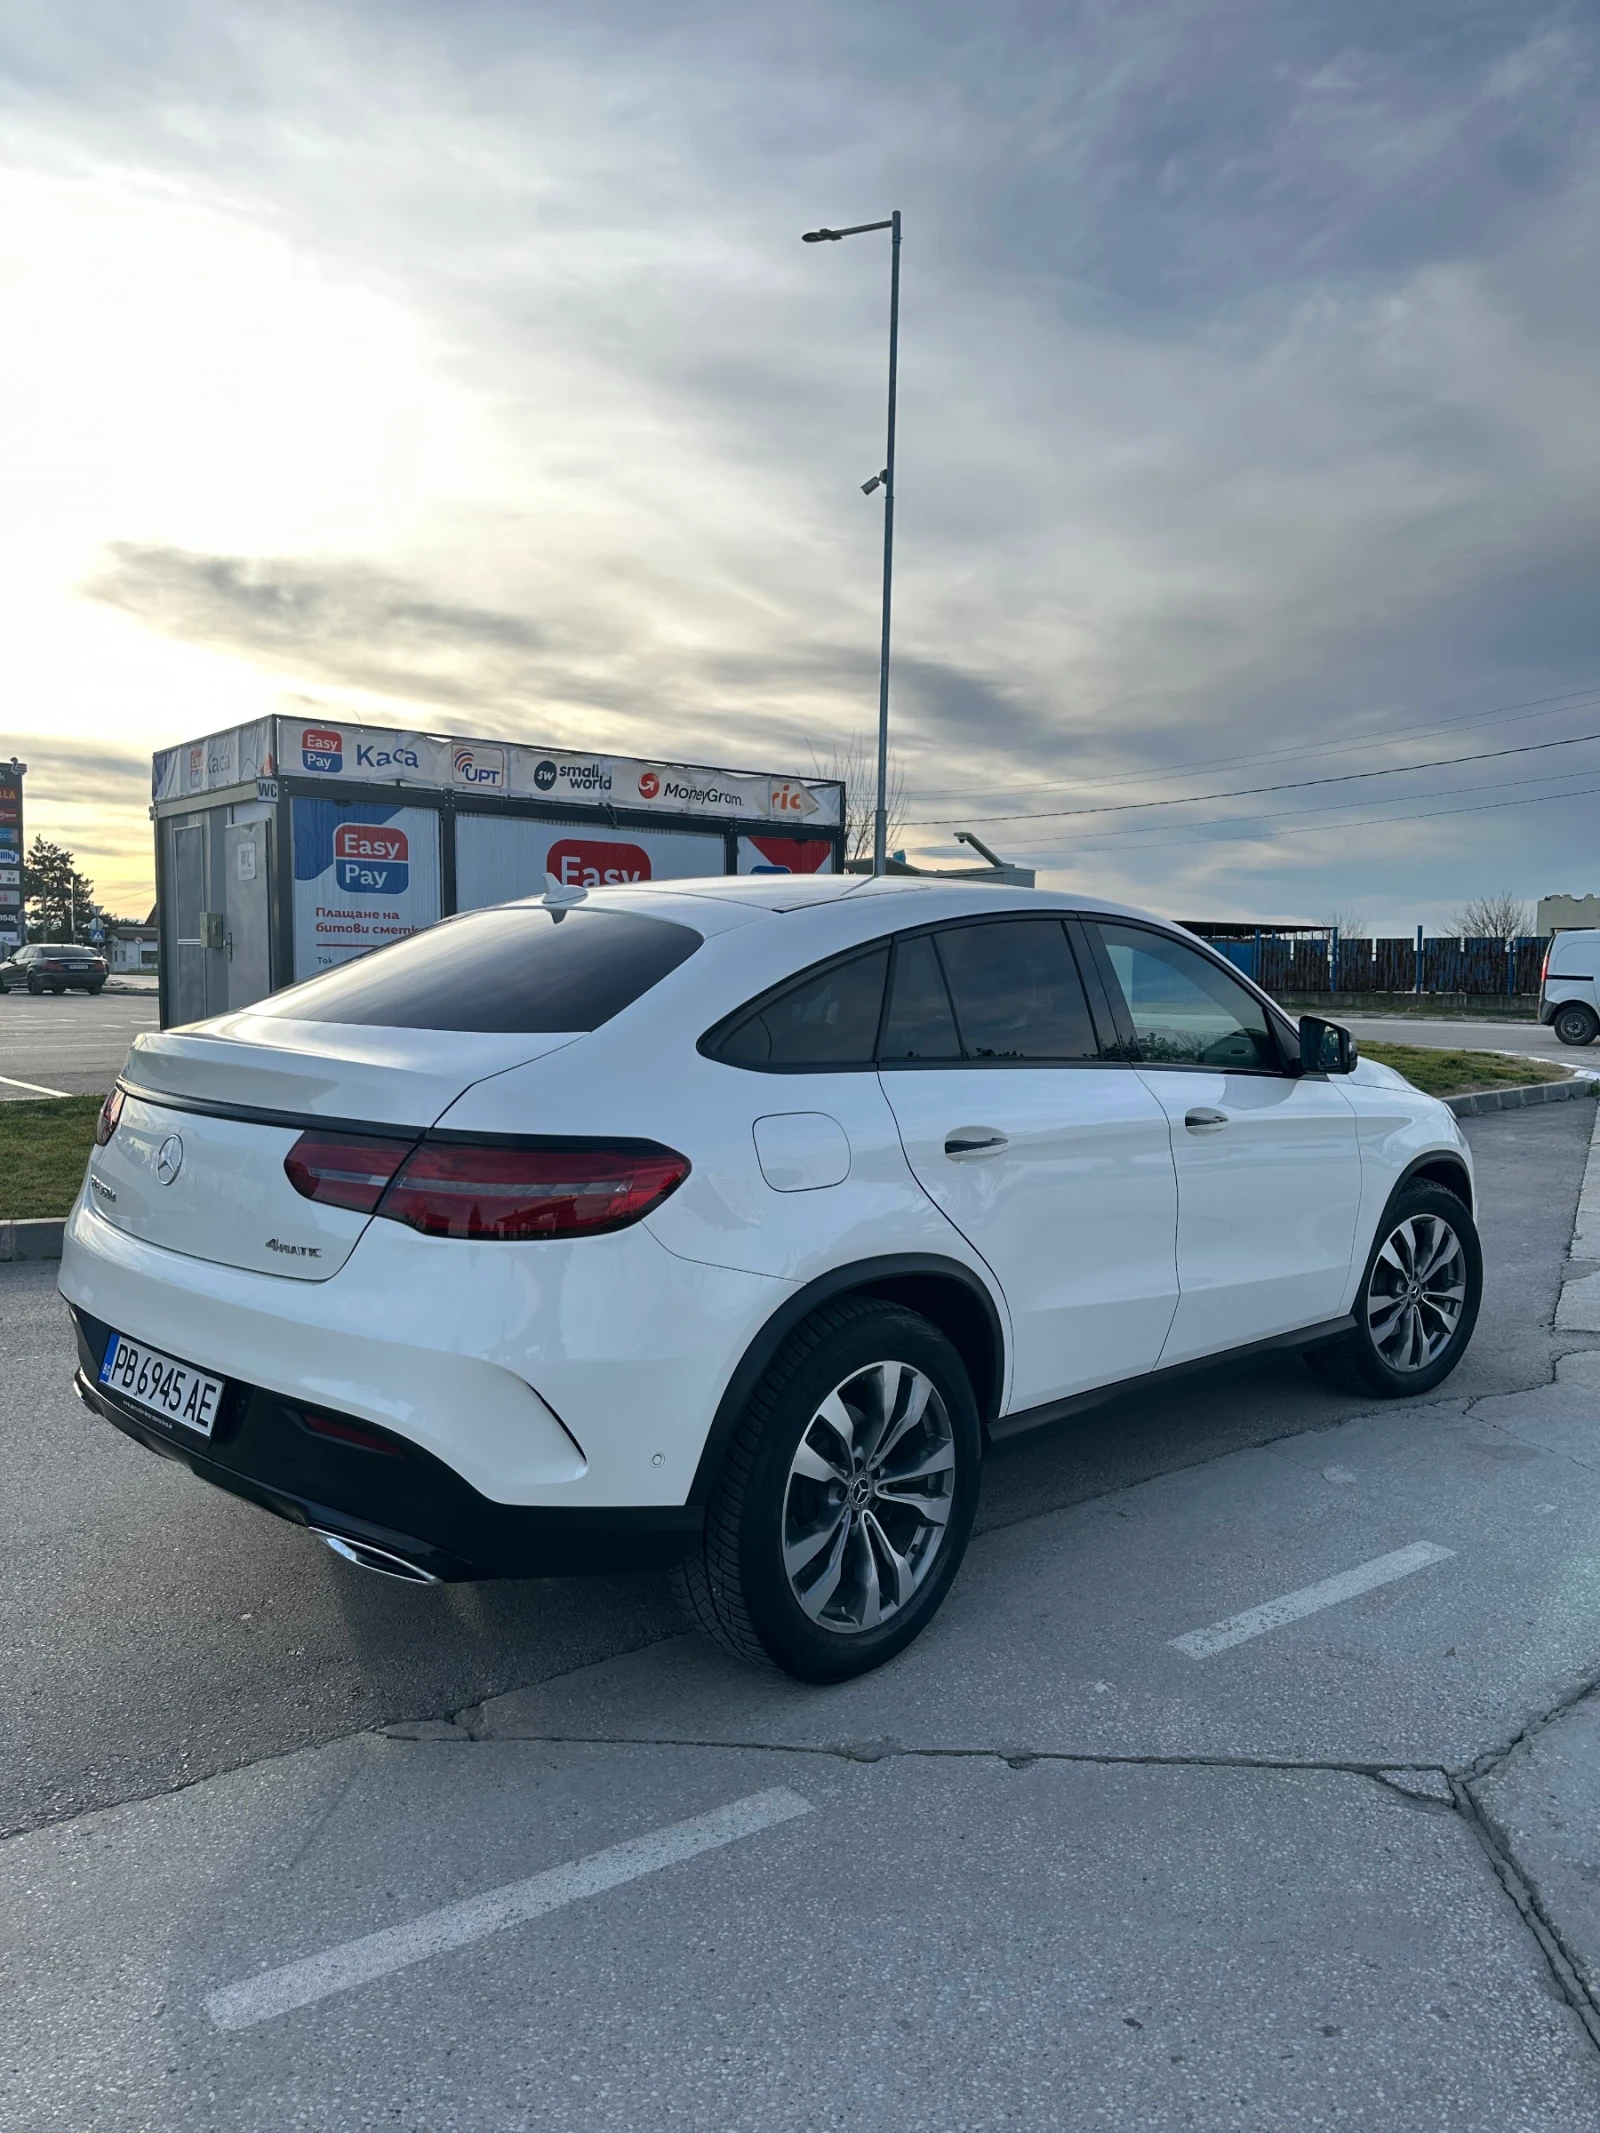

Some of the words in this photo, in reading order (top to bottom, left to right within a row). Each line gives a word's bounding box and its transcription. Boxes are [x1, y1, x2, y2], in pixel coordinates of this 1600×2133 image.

[307, 734, 338, 751] Easy
[307, 753, 332, 770] Pay
[356, 744, 419, 768] Каса
[465, 766, 500, 785] UPT
[559, 764, 600, 779] small
[258, 783, 278, 798] WC
[569, 775, 612, 790] world
[344, 833, 400, 859] Easy
[345, 863, 388, 888] Pay
[315, 907, 380, 920] Плащане
[383, 911, 400, 920] на
[315, 922, 369, 934] битови
[317, 956, 334, 965] Ток
